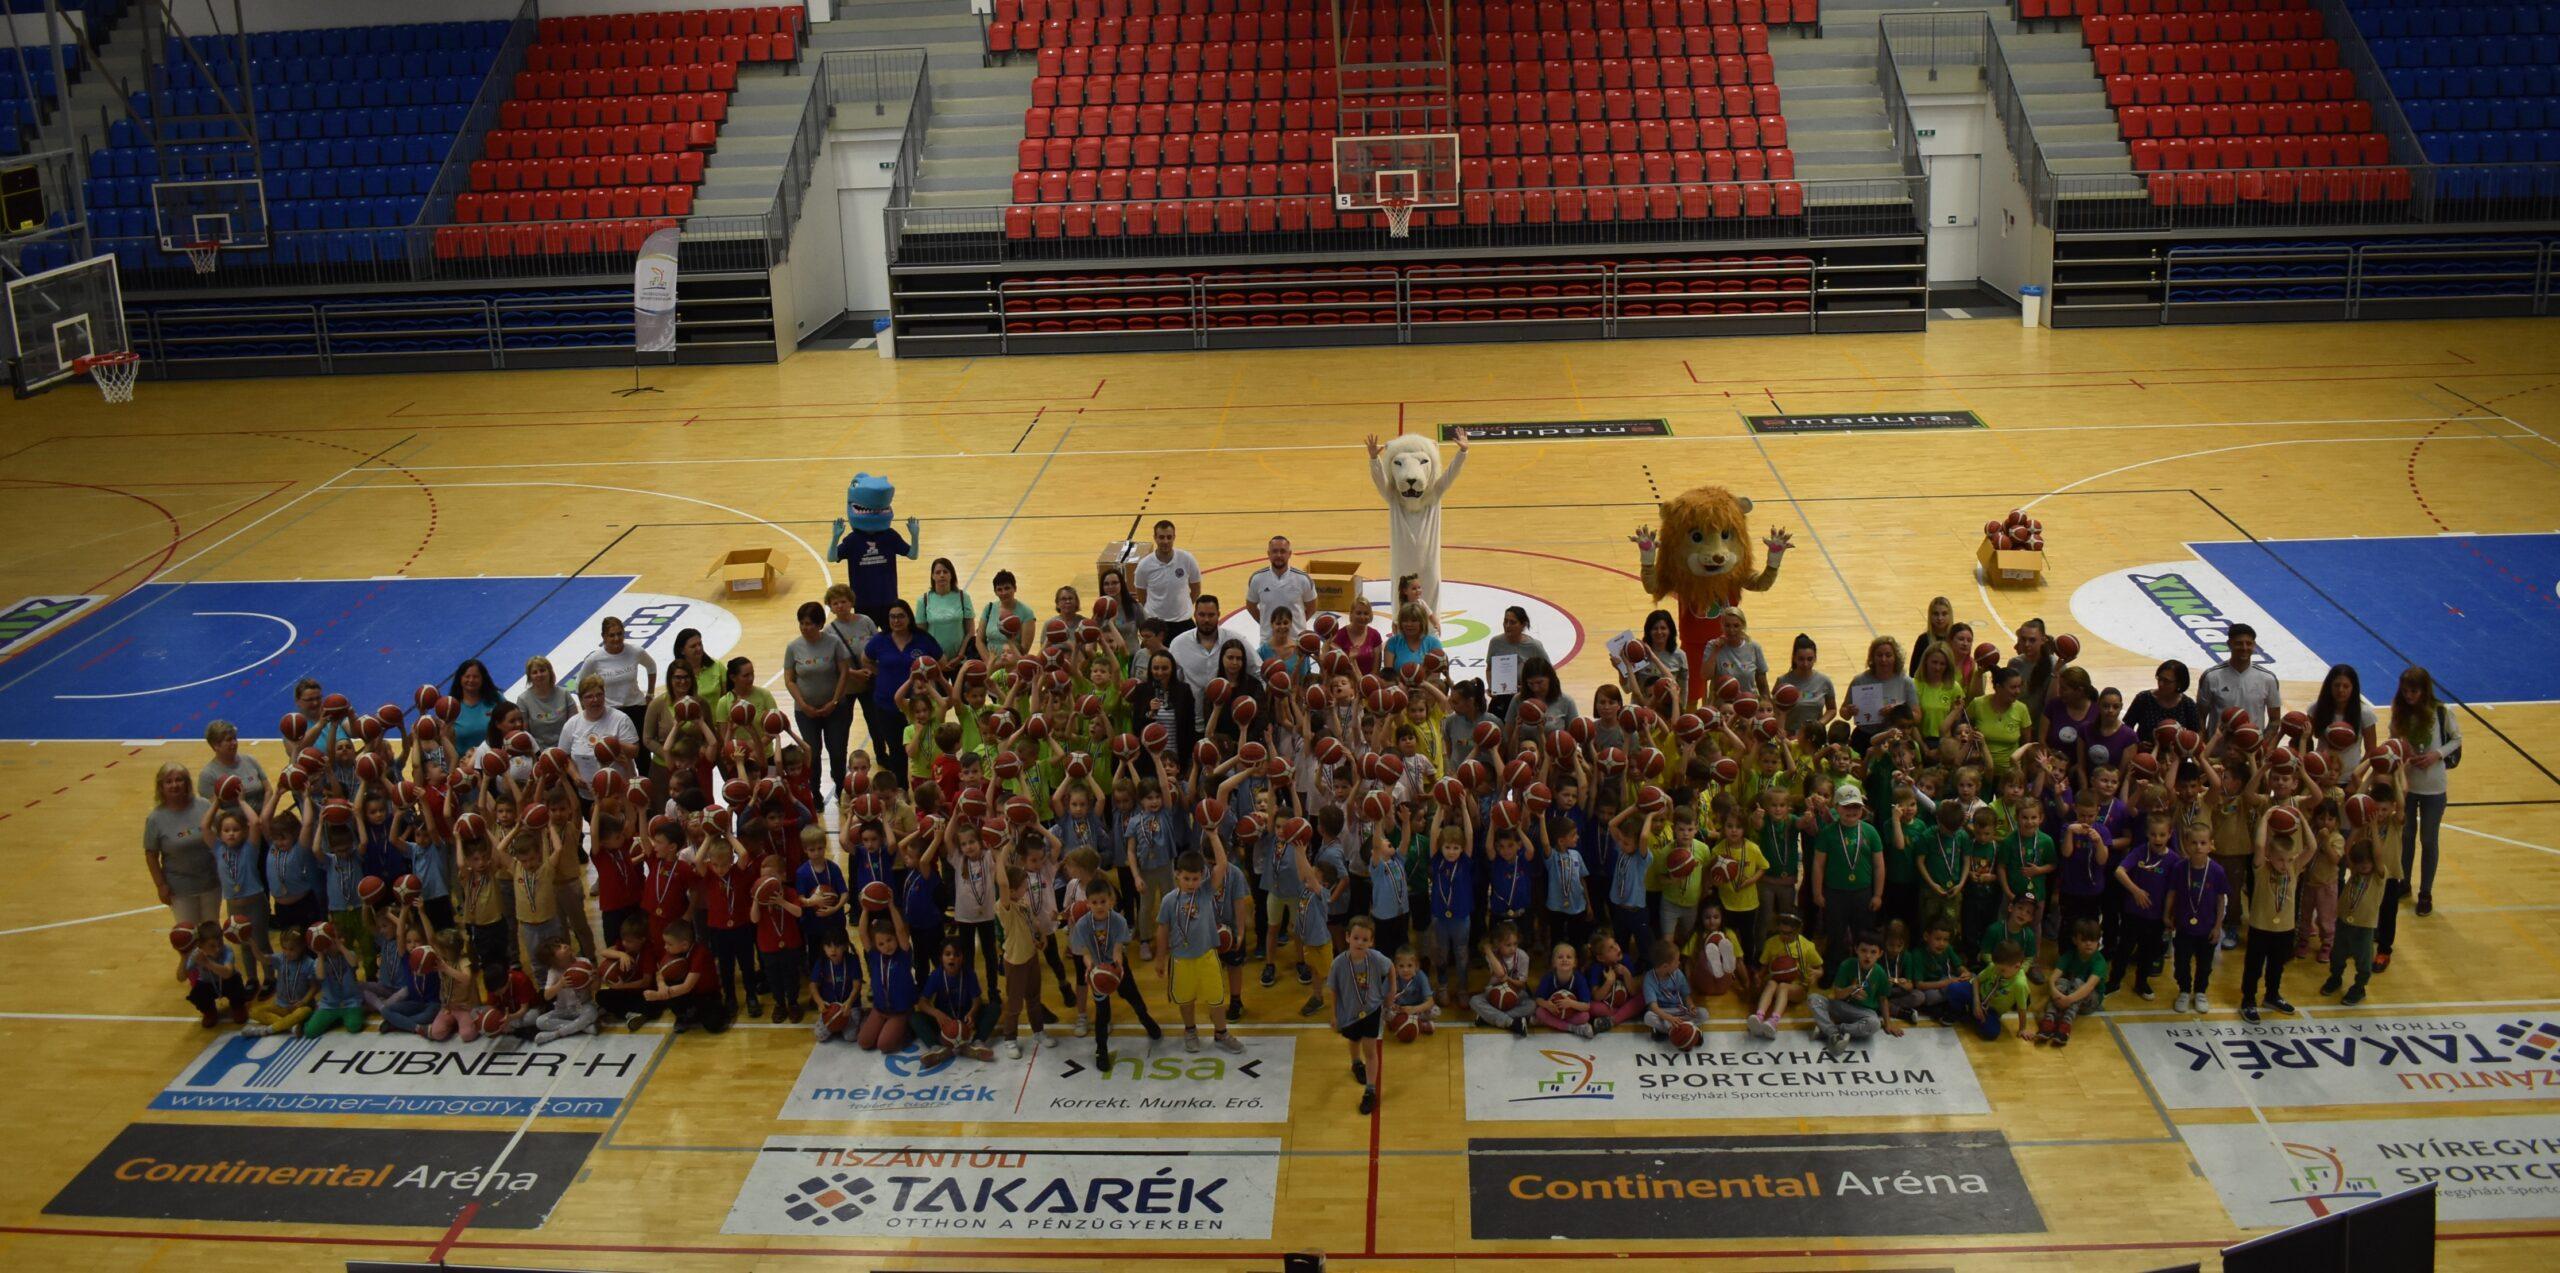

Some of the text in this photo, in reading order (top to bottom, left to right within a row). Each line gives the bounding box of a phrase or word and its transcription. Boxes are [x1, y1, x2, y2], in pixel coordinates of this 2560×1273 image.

[2350, 1024, 2363, 1032] A
[2375, 1021, 2466, 1033] OTTHON
[308, 1048, 638, 1078] HÜBNER-H
[1102, 1048, 1224, 1081] hsa
[1636, 1048, 1870, 1067] NYÍREGYHÁZI
[2174, 1034, 2512, 1079] TAKARÉK
[1639, 1069, 1936, 1088] SPORTCENTRUM
[811, 1083, 997, 1102] meló-diák
[1642, 1085, 1942, 1101] Nyíregyházi Sportcentrum Nonprofit Kft.
[171, 1094, 605, 1116] www.hubner-hungary.com
[1051, 1097, 1130, 1108] Korrekt.
[1140, 1097, 1216, 1108] Munka.
[115, 1156, 539, 1192] Continental Aréna
[887, 1167, 1229, 1214] TAKARÉK
[1508, 1169, 1989, 1200] Continental Aréna
[886, 1214, 1222, 1230] OTTHON A PÉNZÜGYEKBEN
